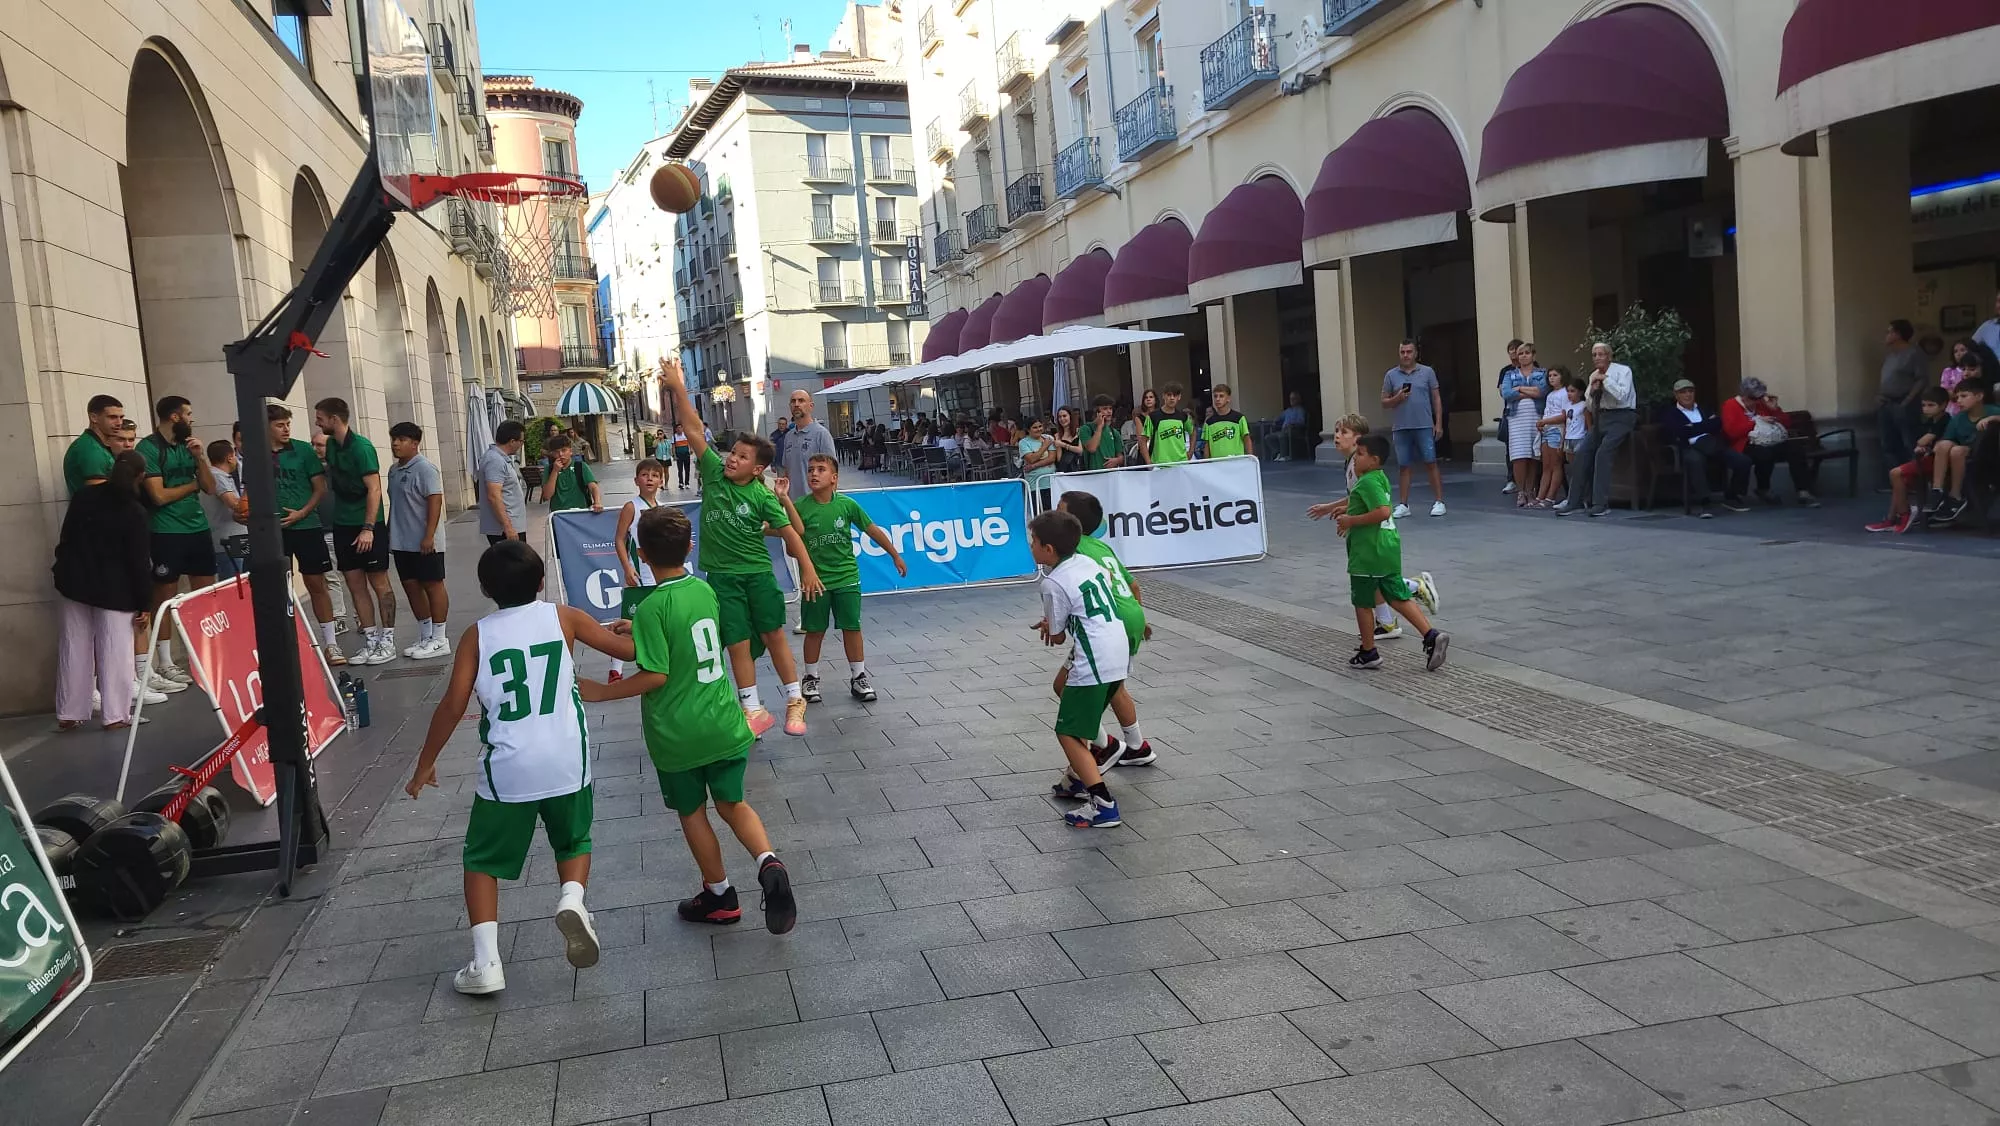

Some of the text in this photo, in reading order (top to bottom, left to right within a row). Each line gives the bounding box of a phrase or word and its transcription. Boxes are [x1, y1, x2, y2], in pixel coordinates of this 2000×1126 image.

[907, 236, 920, 303] HOSTAL
[1108, 496, 1259, 539] méstica
[200, 610, 230, 638] GRUPO
[691, 618, 724, 684] 9
[489, 640, 563, 722] 37
[57, 874, 77, 890] NBA
[26, 950, 72, 996] #HuescaFauna
